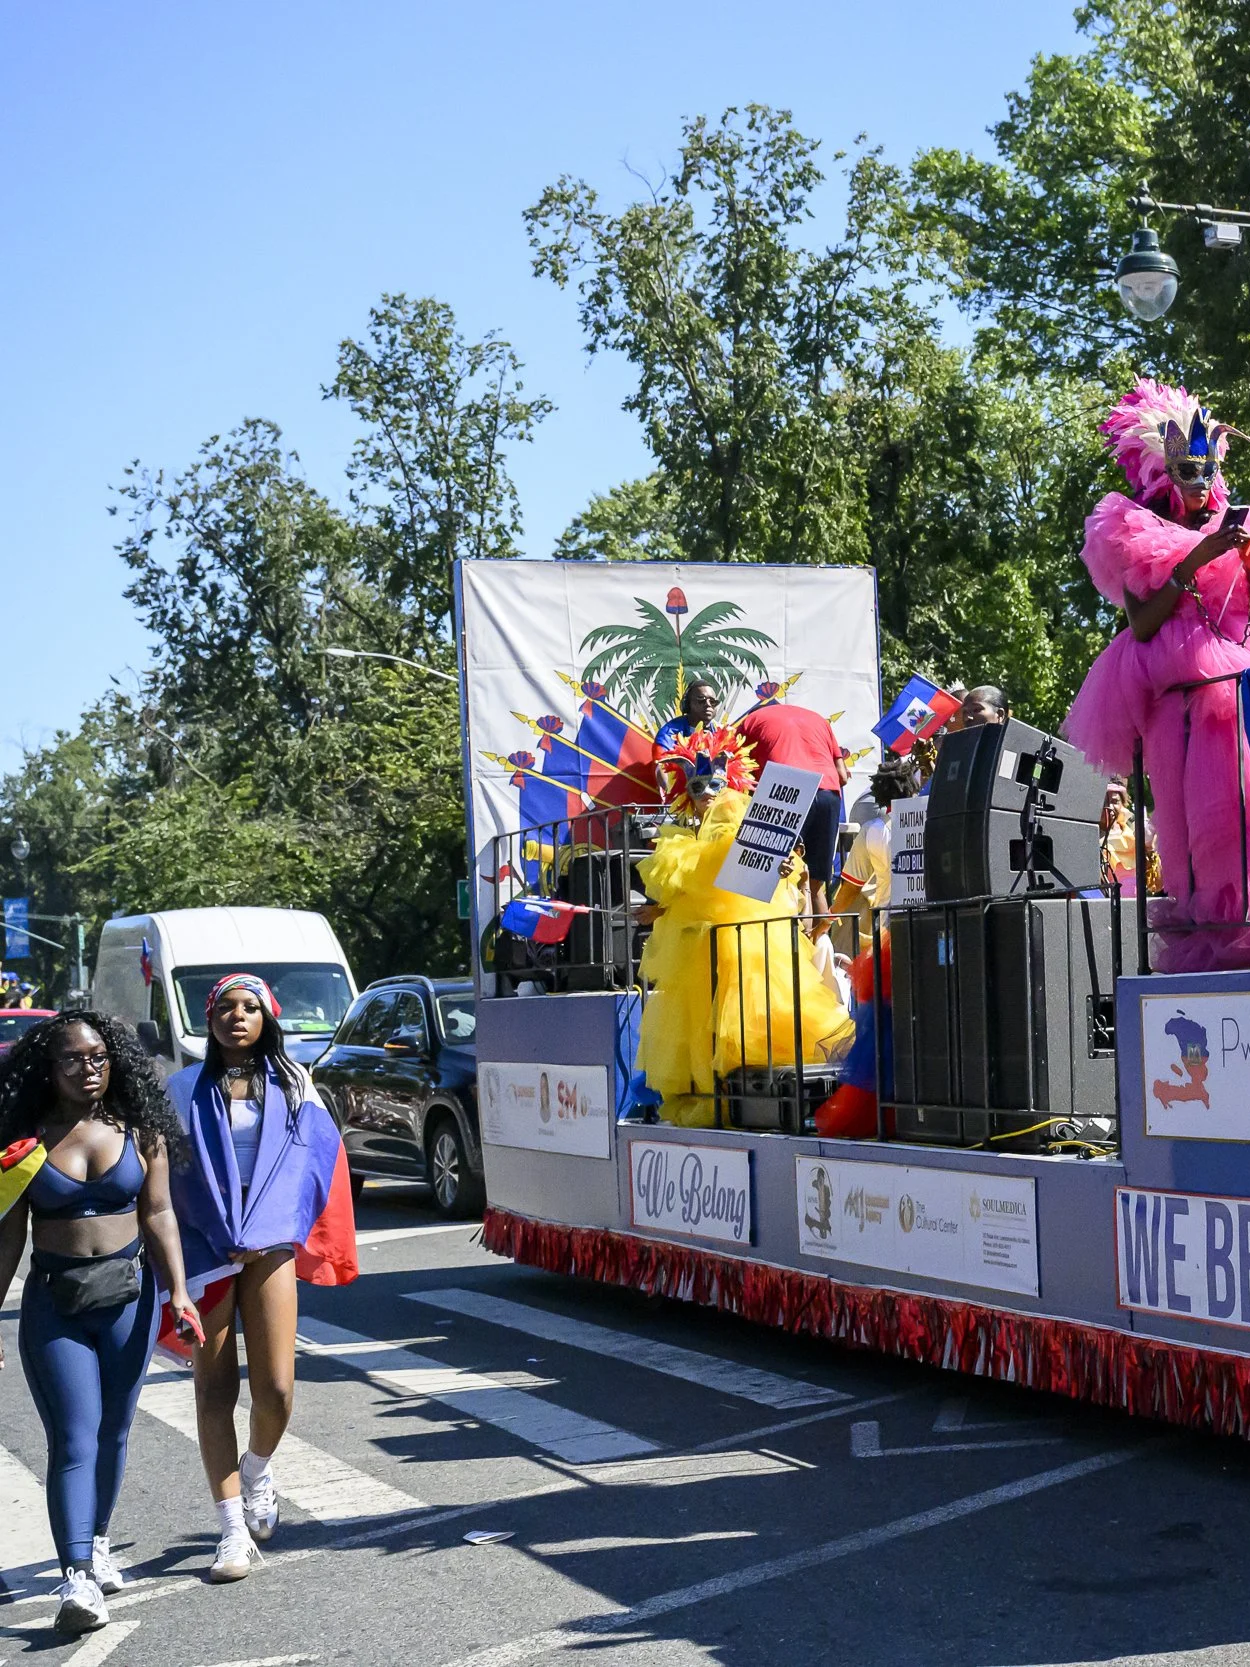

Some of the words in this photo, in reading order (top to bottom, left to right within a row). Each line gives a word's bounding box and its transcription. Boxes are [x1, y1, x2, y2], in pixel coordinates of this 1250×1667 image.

[769, 783, 800, 805] LABOR
[748, 802, 784, 826] RIGHTS
[781, 811, 803, 830] ARE
[899, 810, 924, 828] HAITIAN
[738, 823, 794, 853] IMMIGRANT
[738, 848, 775, 873] RIGHTS
[897, 854, 911, 872] ADD
[907, 876, 915, 892] TO
[916, 875, 926, 892] OU
[637, 1149, 676, 1219] We
[680, 1152, 746, 1240] Belong
[915, 1200, 926, 1214] The
[982, 1198, 1027, 1216] SOULMEDICA
[915, 1215, 938, 1232] Cultural
[939, 1217, 959, 1234] Center
[1121, 1192, 1192, 1314] WE
